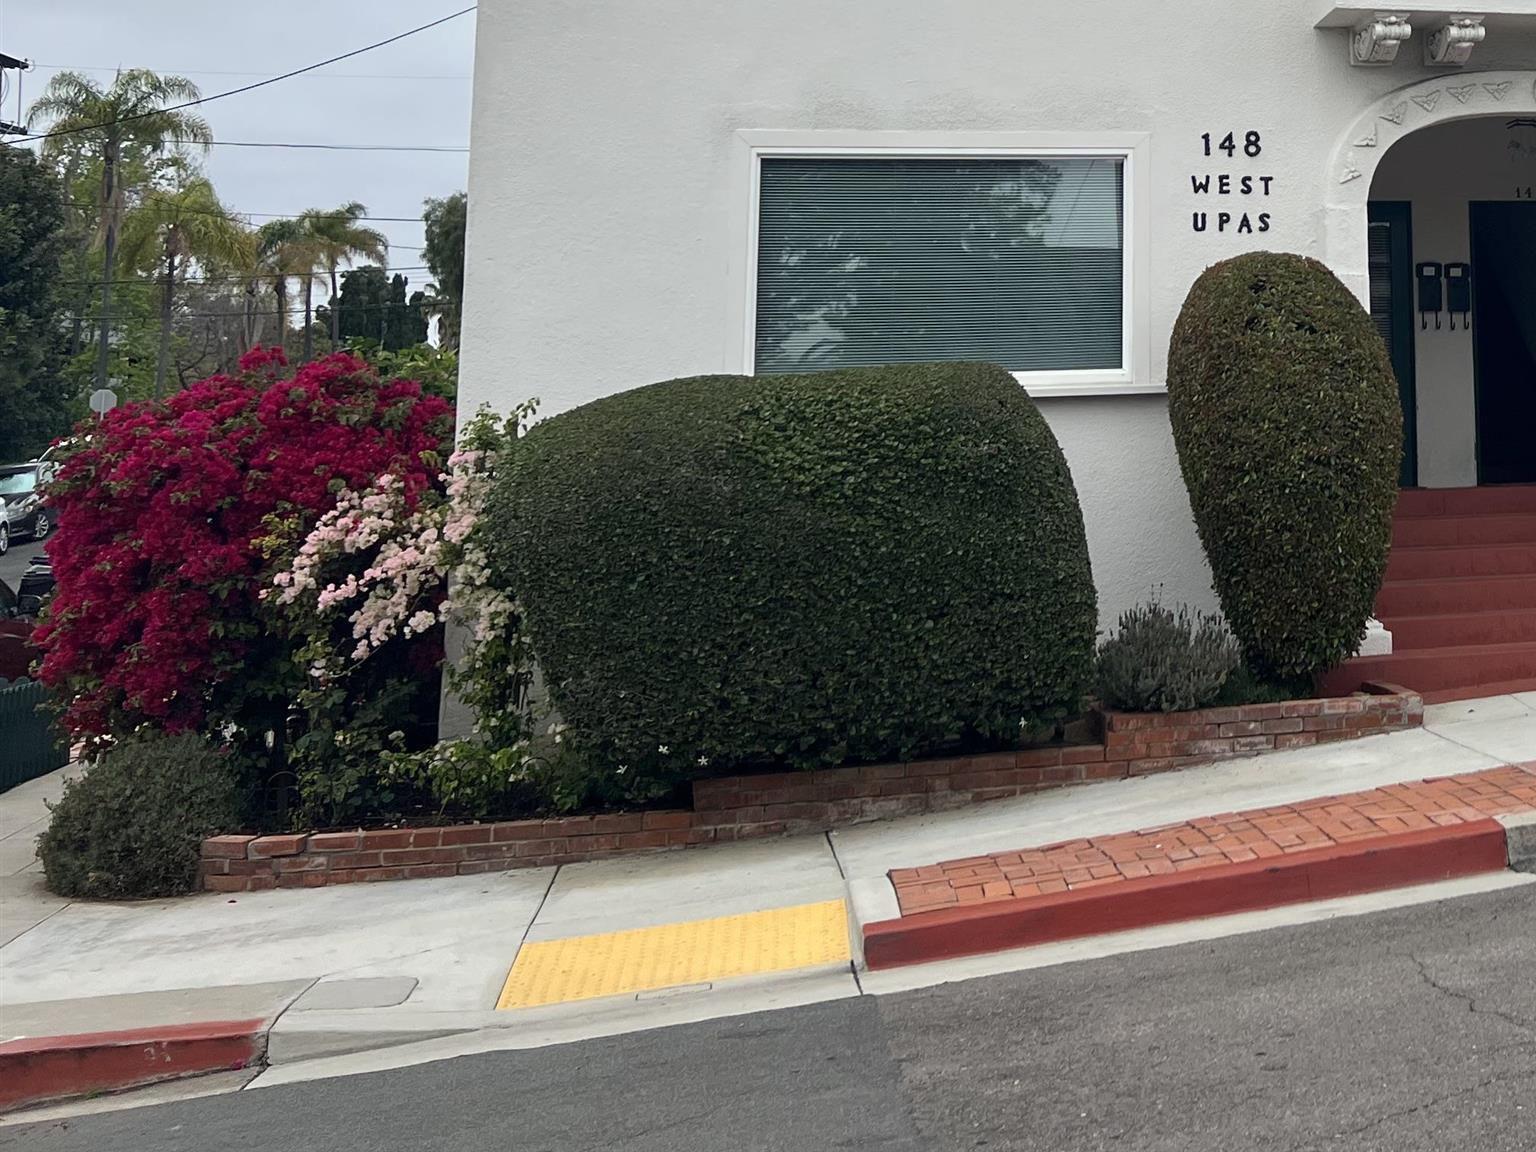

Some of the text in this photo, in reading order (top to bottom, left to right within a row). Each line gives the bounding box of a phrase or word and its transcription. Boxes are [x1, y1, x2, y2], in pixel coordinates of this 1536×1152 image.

[1201, 130, 1262, 157] 148
[1191, 174, 1274, 195] WEST
[1193, 212, 1271, 234] UPAS
